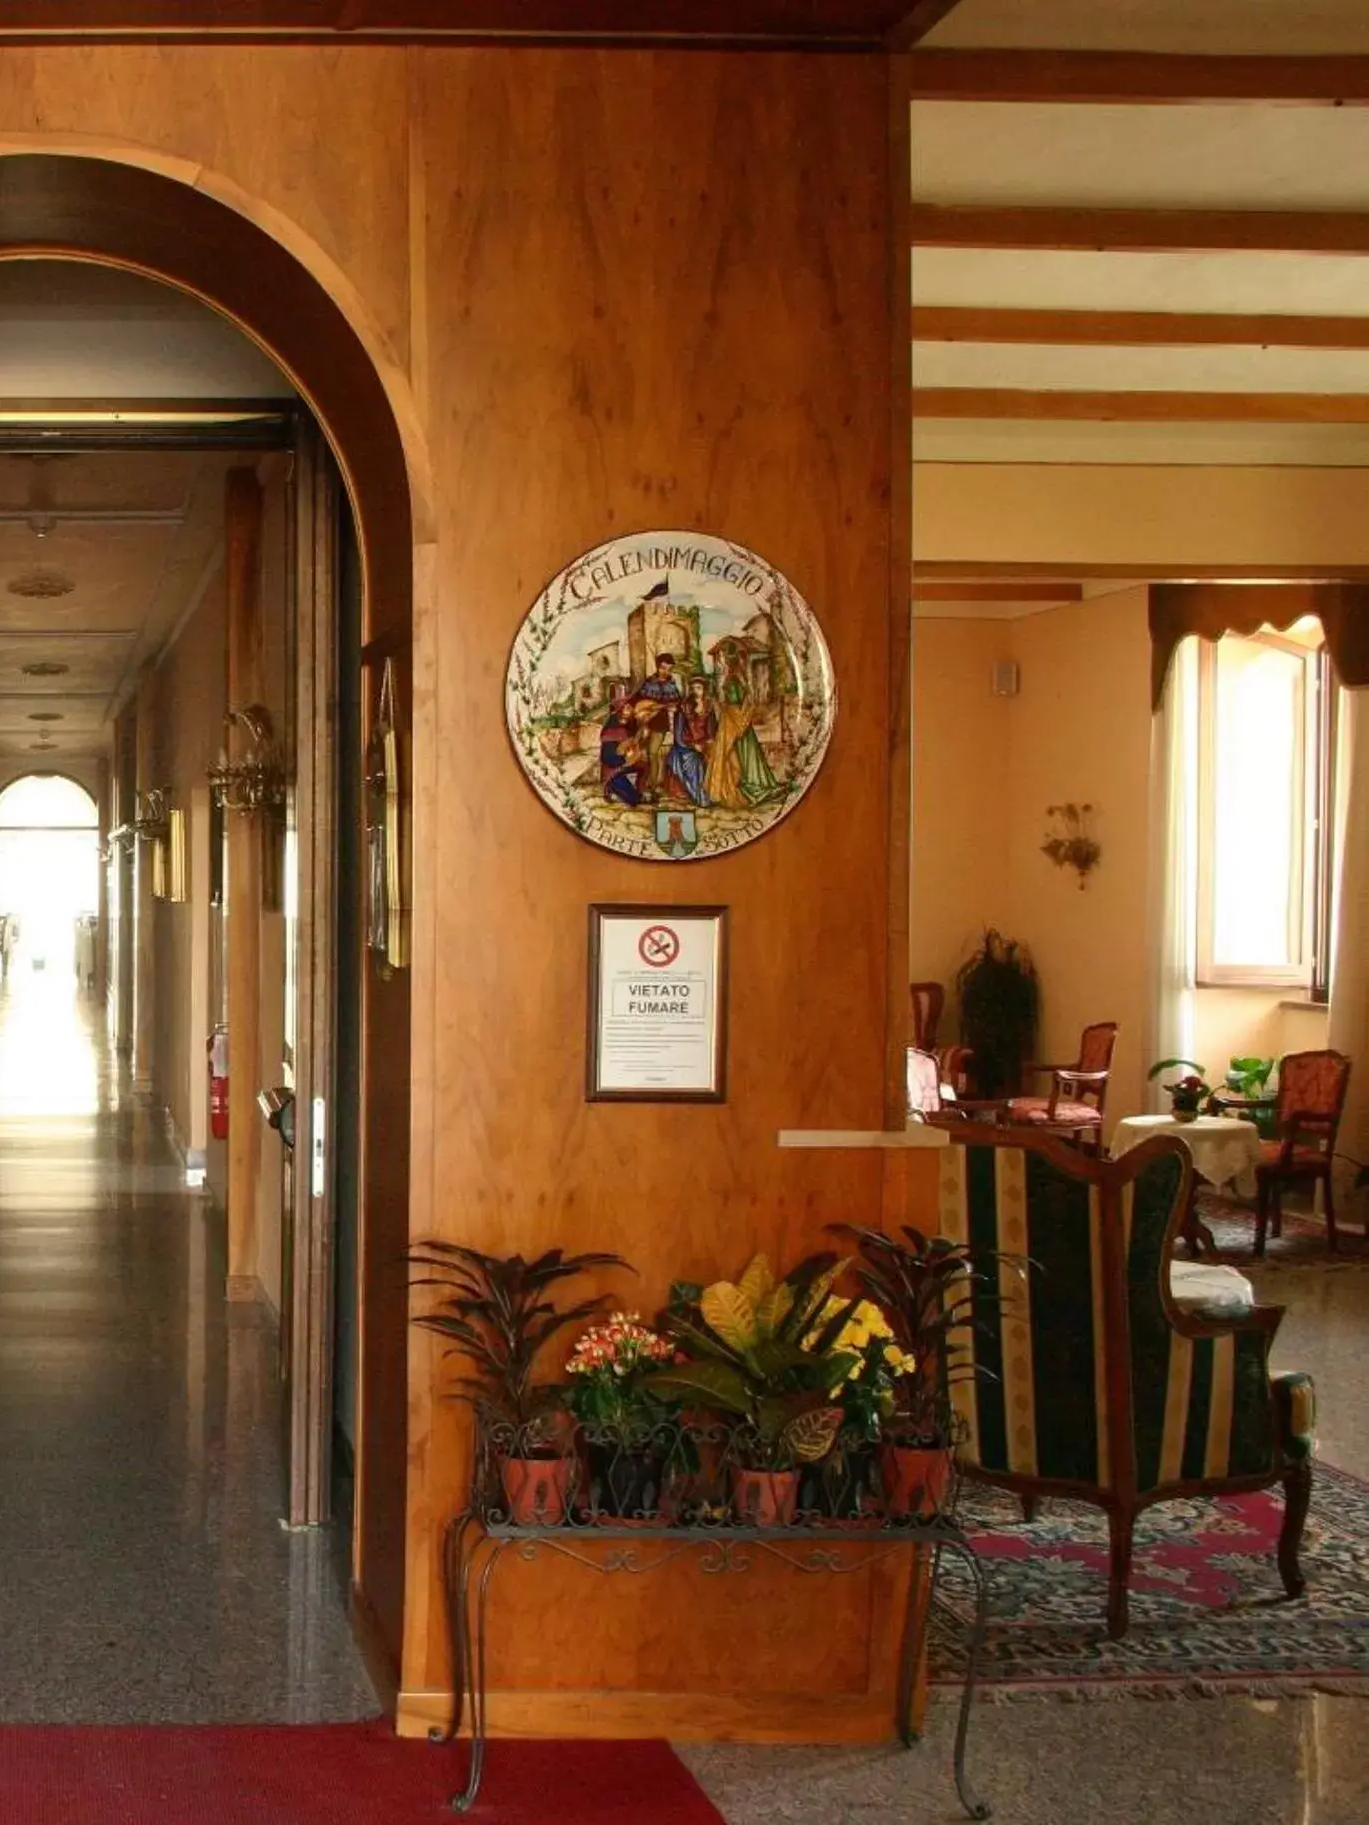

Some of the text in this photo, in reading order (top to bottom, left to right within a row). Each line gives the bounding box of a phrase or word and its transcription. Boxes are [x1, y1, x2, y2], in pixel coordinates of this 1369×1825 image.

[571, 547, 764, 599] CALENDIMAGGIO
[586, 815, 764, 857] PARTE SOTTO
[629, 984, 690, 997] VIETATO
[629, 1001, 689, 1014] FUMARE
